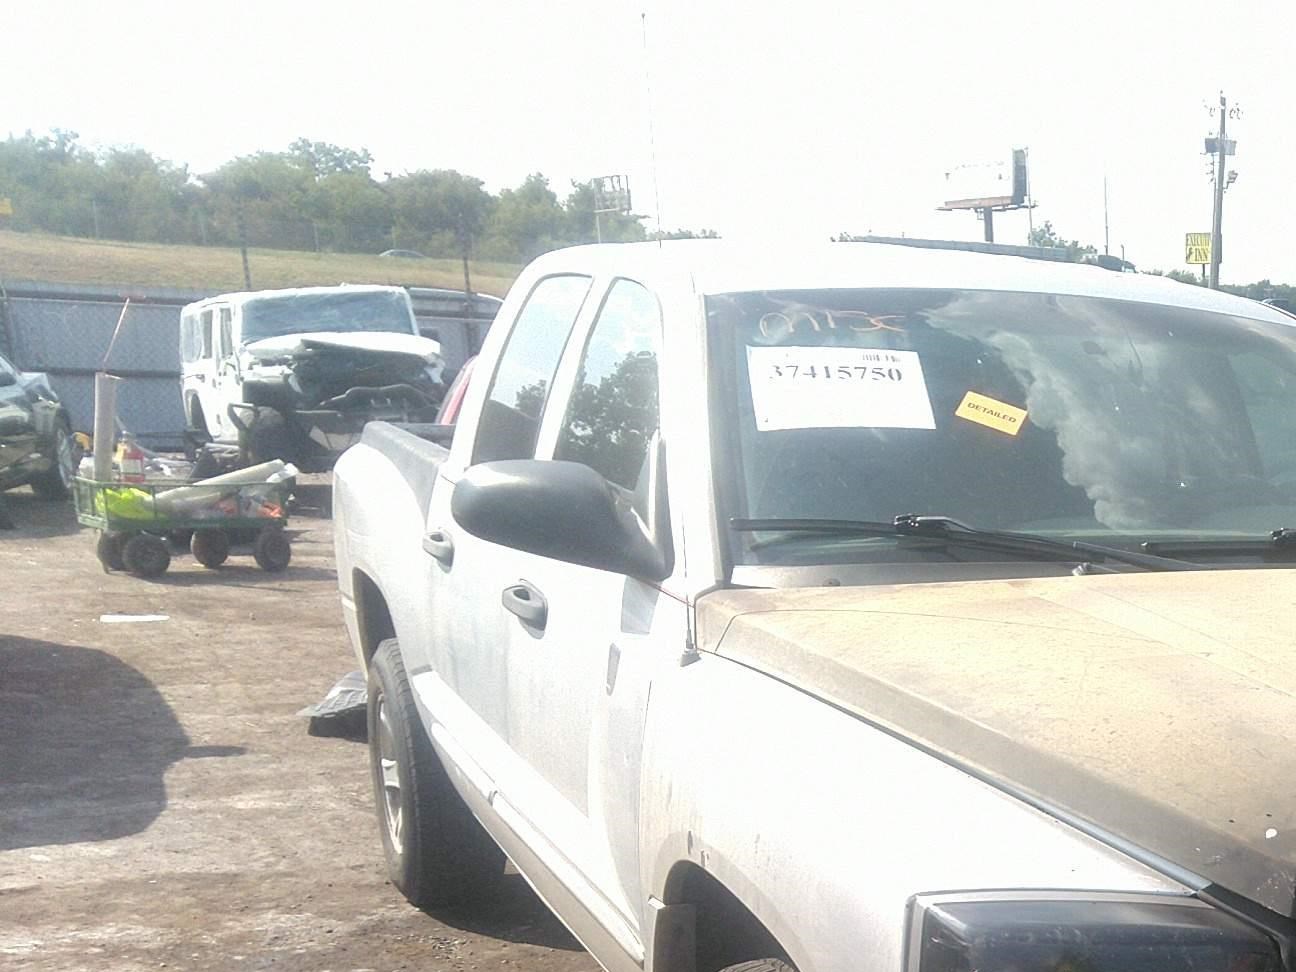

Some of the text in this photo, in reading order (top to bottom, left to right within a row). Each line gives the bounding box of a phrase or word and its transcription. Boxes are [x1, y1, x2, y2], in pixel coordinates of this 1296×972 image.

[1194, 247, 1209, 262] INN
[769, 365, 903, 382] 37415750
[967, 402, 1018, 424] DETAILED
